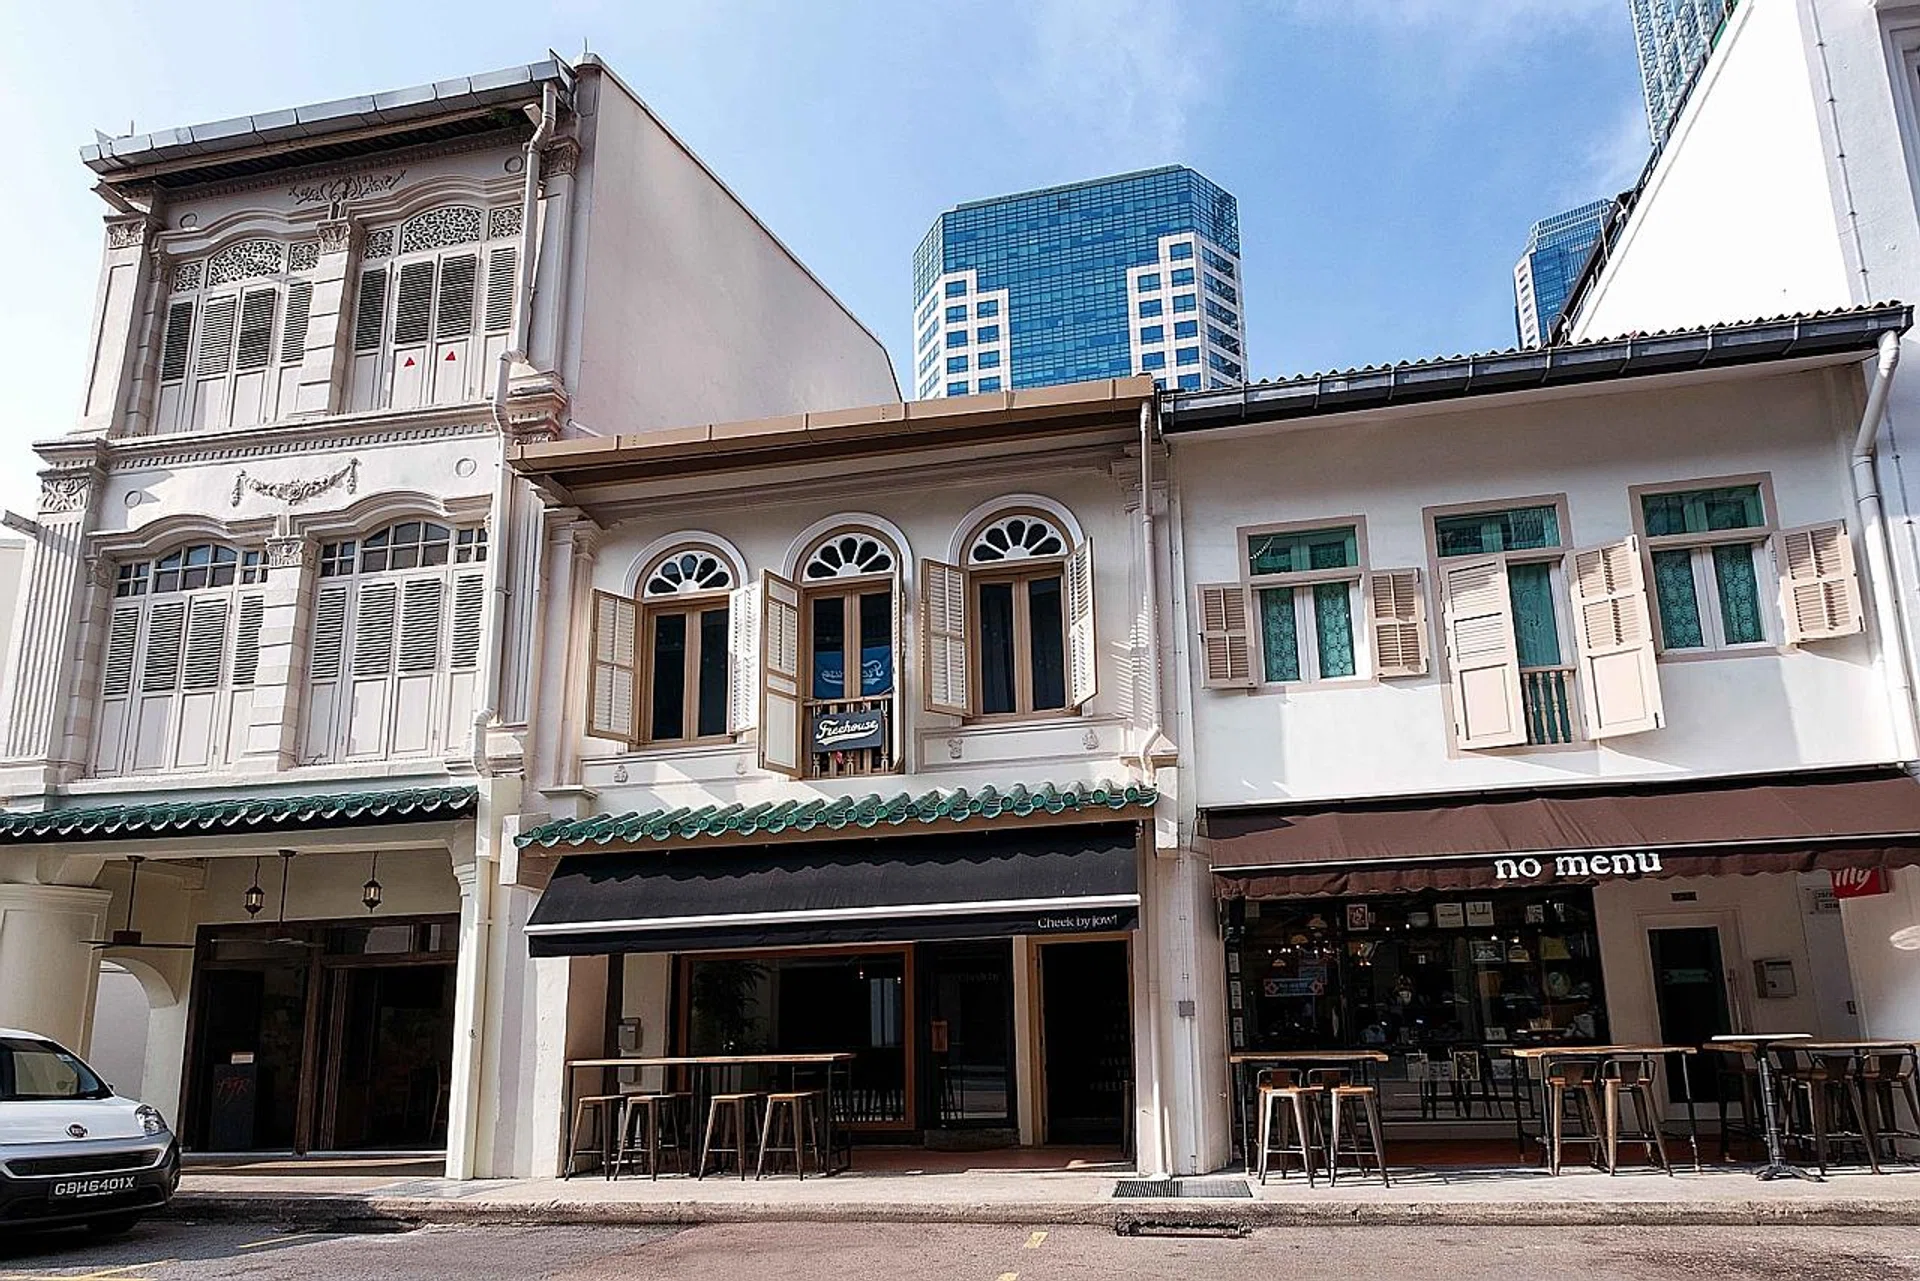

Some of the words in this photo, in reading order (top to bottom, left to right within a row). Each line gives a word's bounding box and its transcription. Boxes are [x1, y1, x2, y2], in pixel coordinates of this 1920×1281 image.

[815, 719, 879, 743] Freehouse
[1494, 857, 1542, 879] no
[1555, 852, 1663, 876] menu
[1037, 916, 1075, 929] Cheek
[1076, 915, 1091, 929] by
[54, 1175, 135, 1196] GBH6401X
